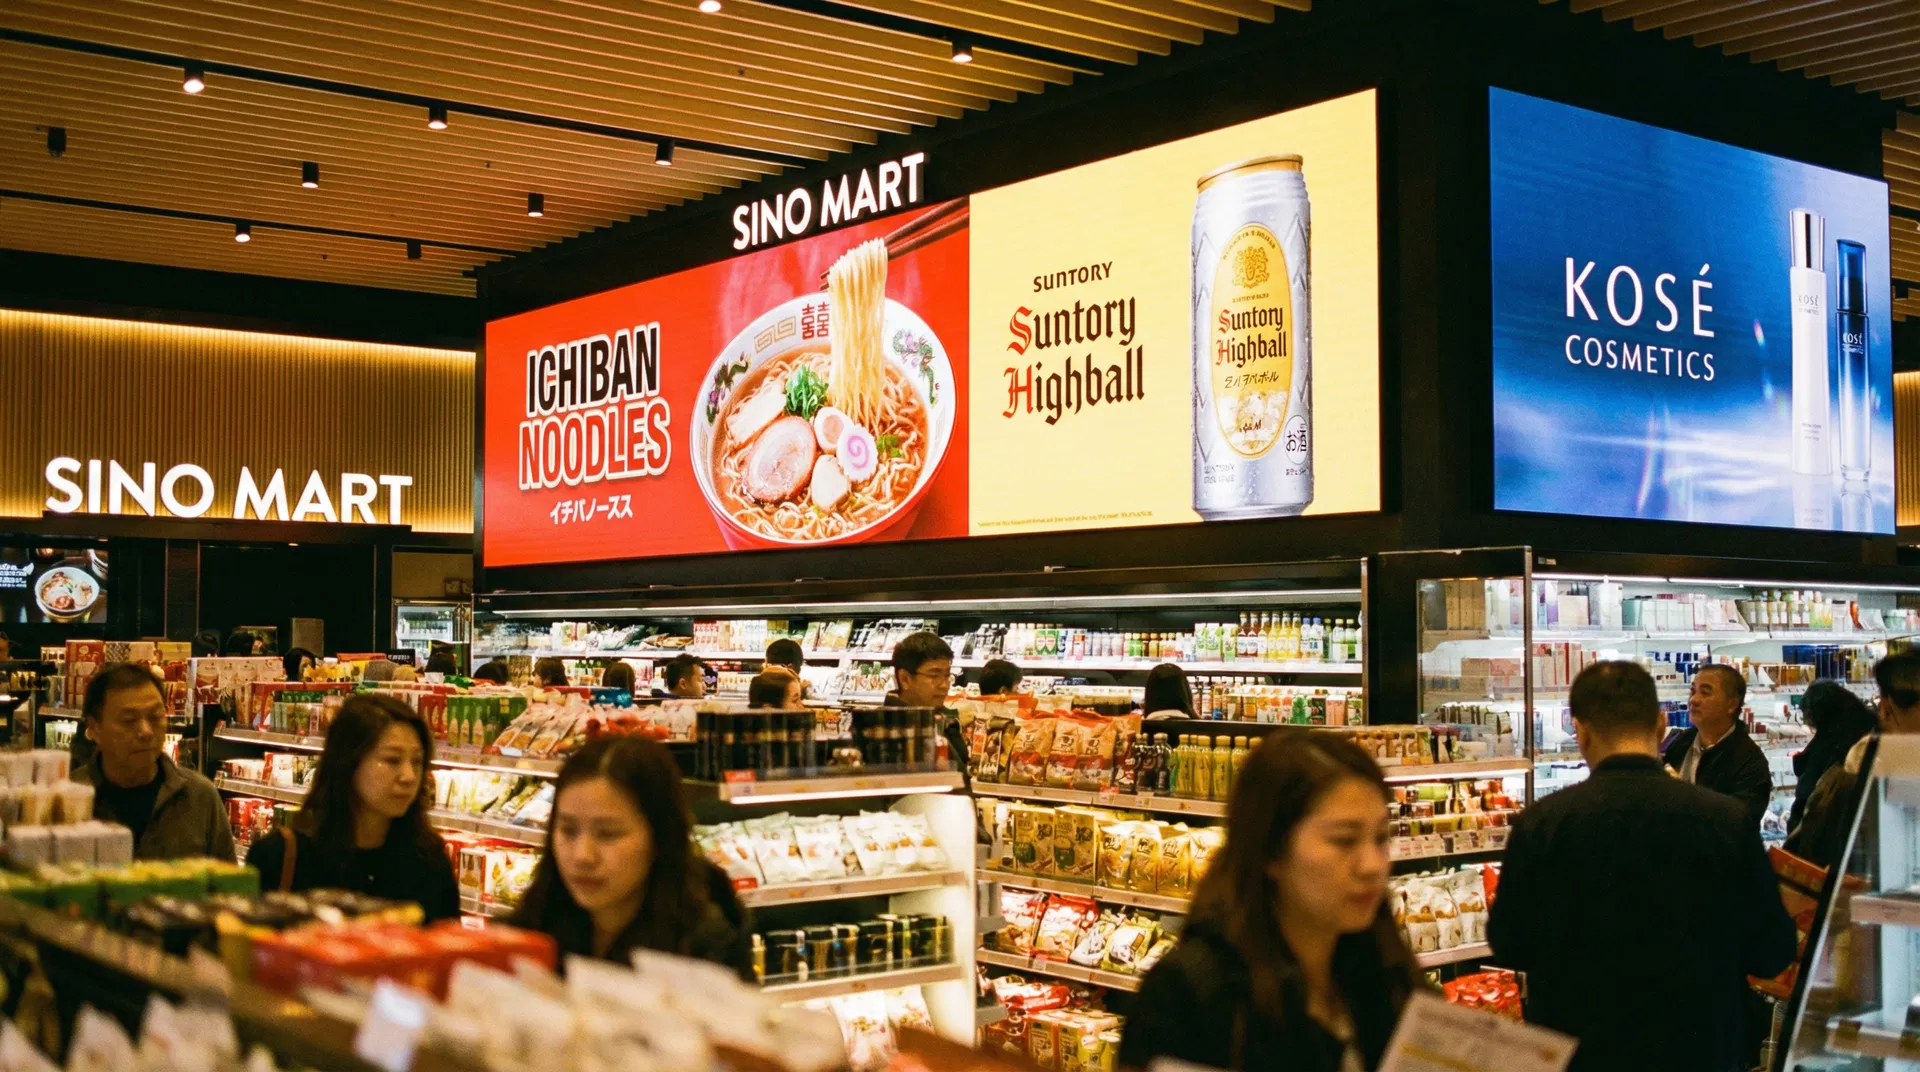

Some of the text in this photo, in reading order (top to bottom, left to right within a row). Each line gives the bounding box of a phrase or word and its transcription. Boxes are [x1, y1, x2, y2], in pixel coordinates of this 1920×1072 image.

[733, 152, 924, 250] SINO MART
[1007, 296, 1137, 357] Suntory
[1218, 306, 1283, 334] Suntory
[1565, 257, 1714, 339] KOSÉ
[526, 322, 661, 417] ICHIBAN
[1002, 345, 1145, 426] Highball
[1215, 331, 1287, 368] Highball
[1565, 333, 1715, 381] COSMETICS
[520, 399, 671, 489] NOODLES
[45, 456, 414, 525] SINO MART
